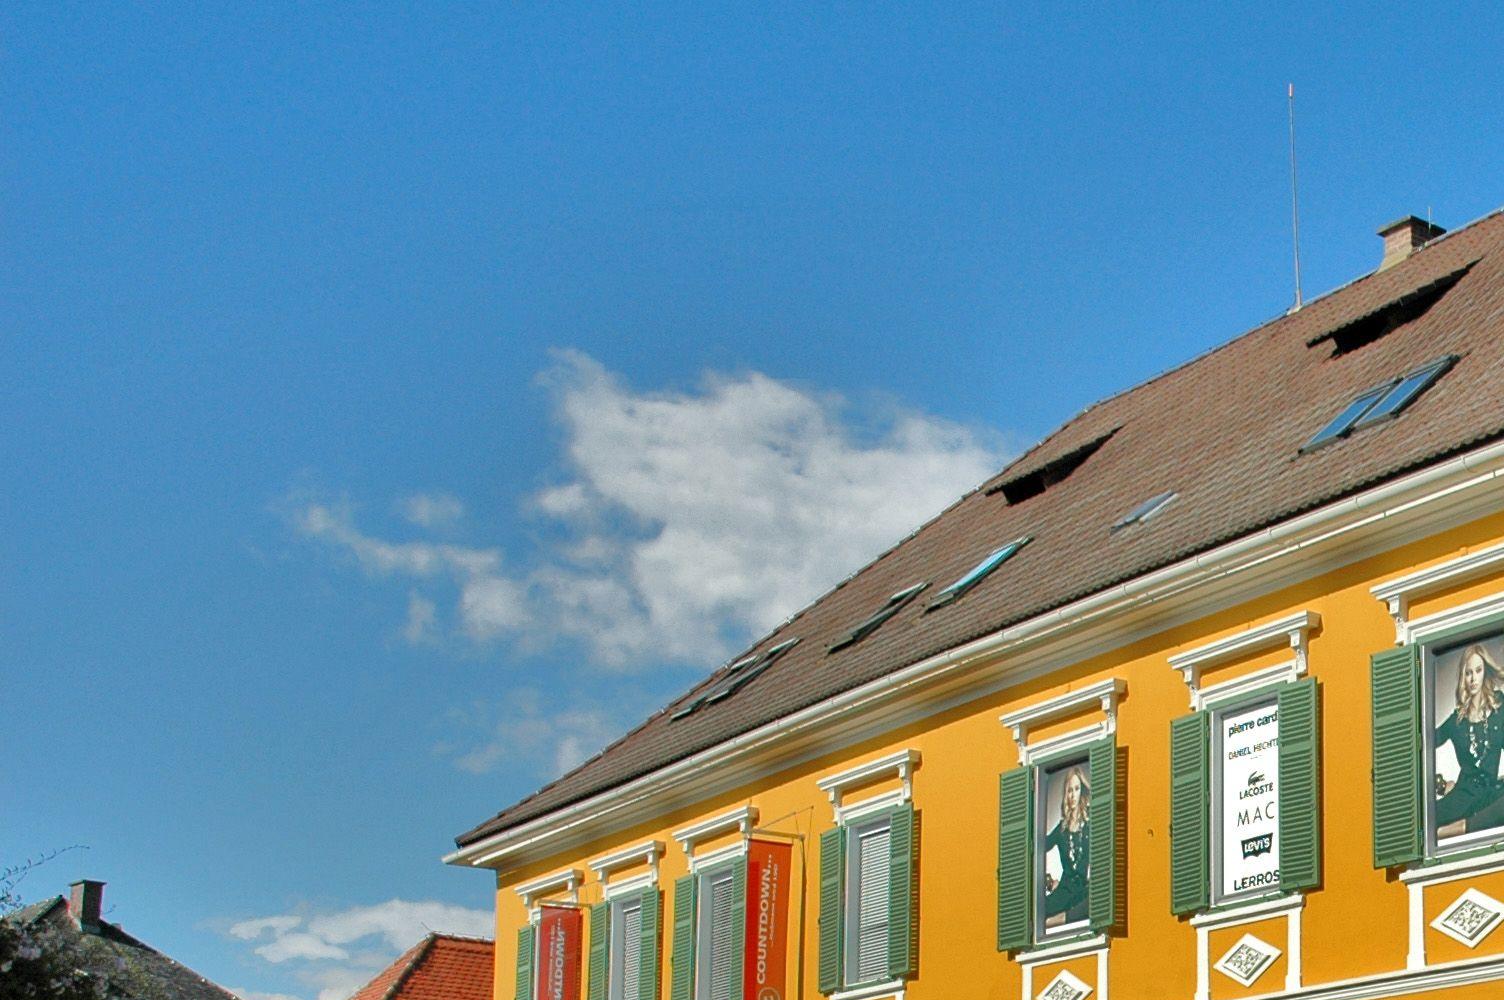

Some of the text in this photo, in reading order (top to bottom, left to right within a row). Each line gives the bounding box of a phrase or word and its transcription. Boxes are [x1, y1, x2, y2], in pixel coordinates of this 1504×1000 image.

[1228, 720, 1255, 738] pierre
[1239, 782, 1274, 800] LACOSTE
[1237, 801, 1275, 827] MAC
[1234, 869, 1280, 891] LERROS
